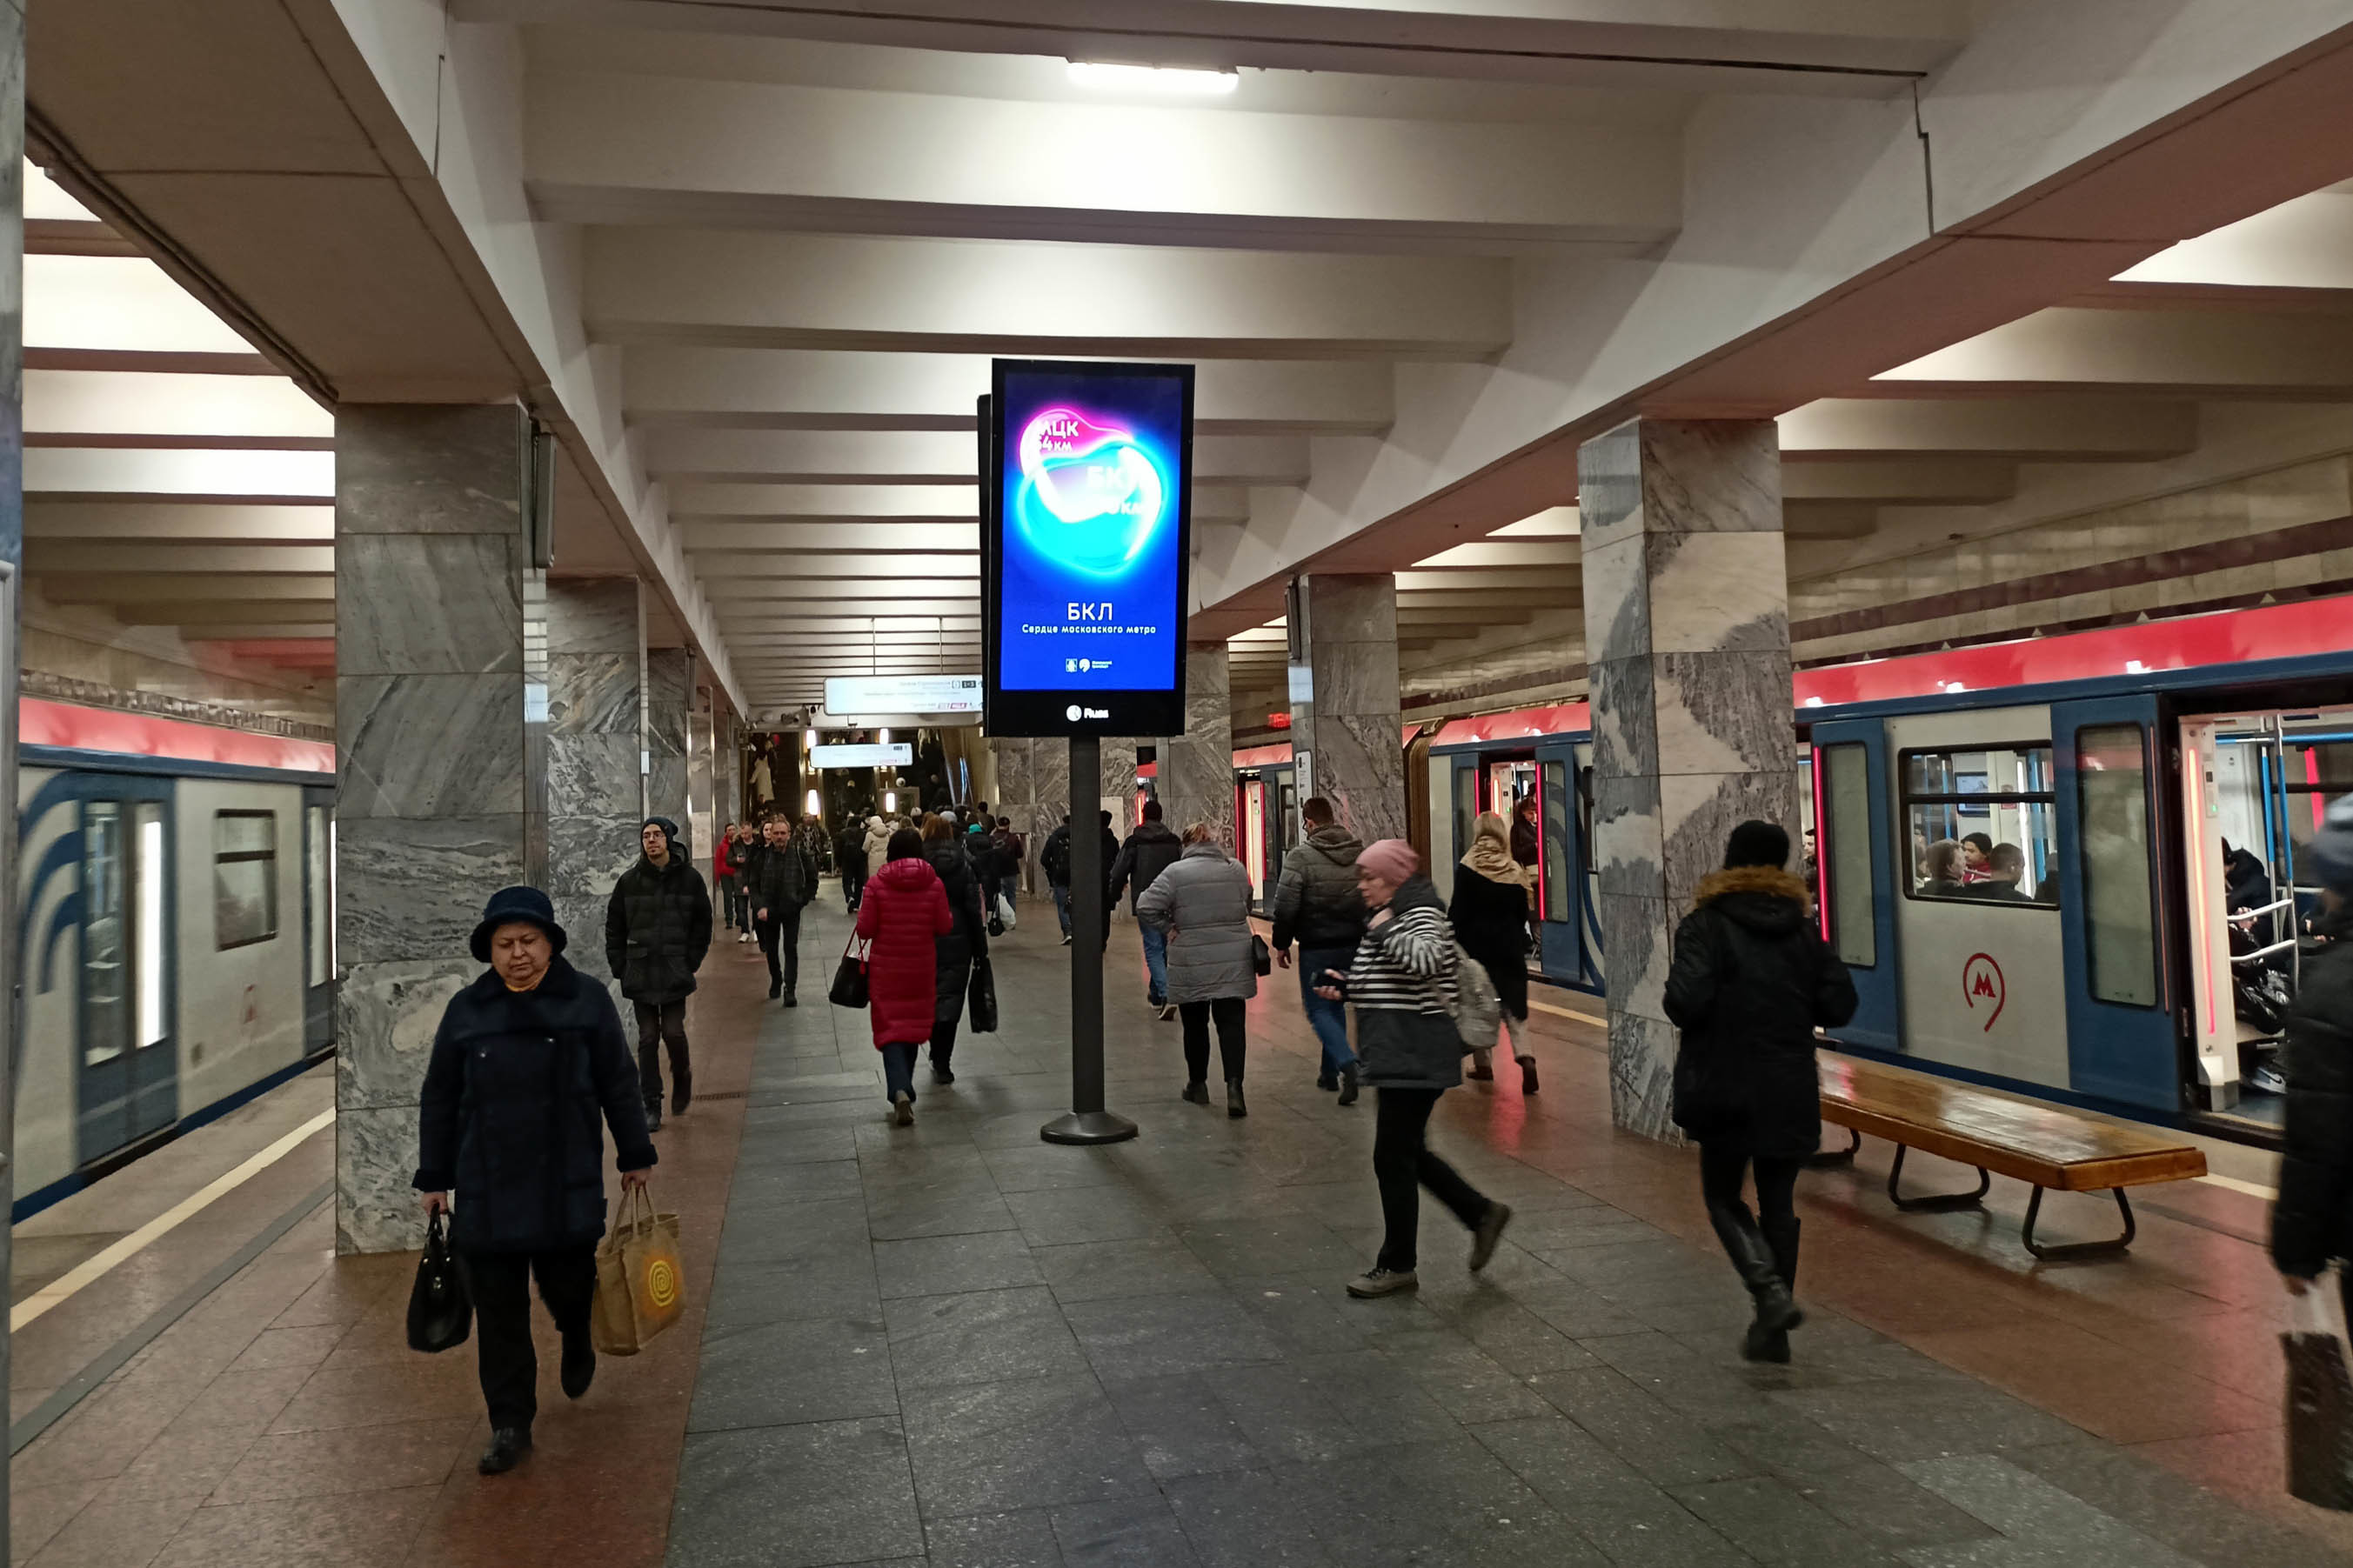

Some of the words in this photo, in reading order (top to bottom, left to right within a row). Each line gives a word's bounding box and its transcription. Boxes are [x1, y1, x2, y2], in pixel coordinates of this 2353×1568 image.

[1067, 602, 1113, 621] БКЛ
[1021, 624, 1059, 635] Сердце
[1061, 625, 1123, 634] московского
[1126, 625, 1156, 635] метро
